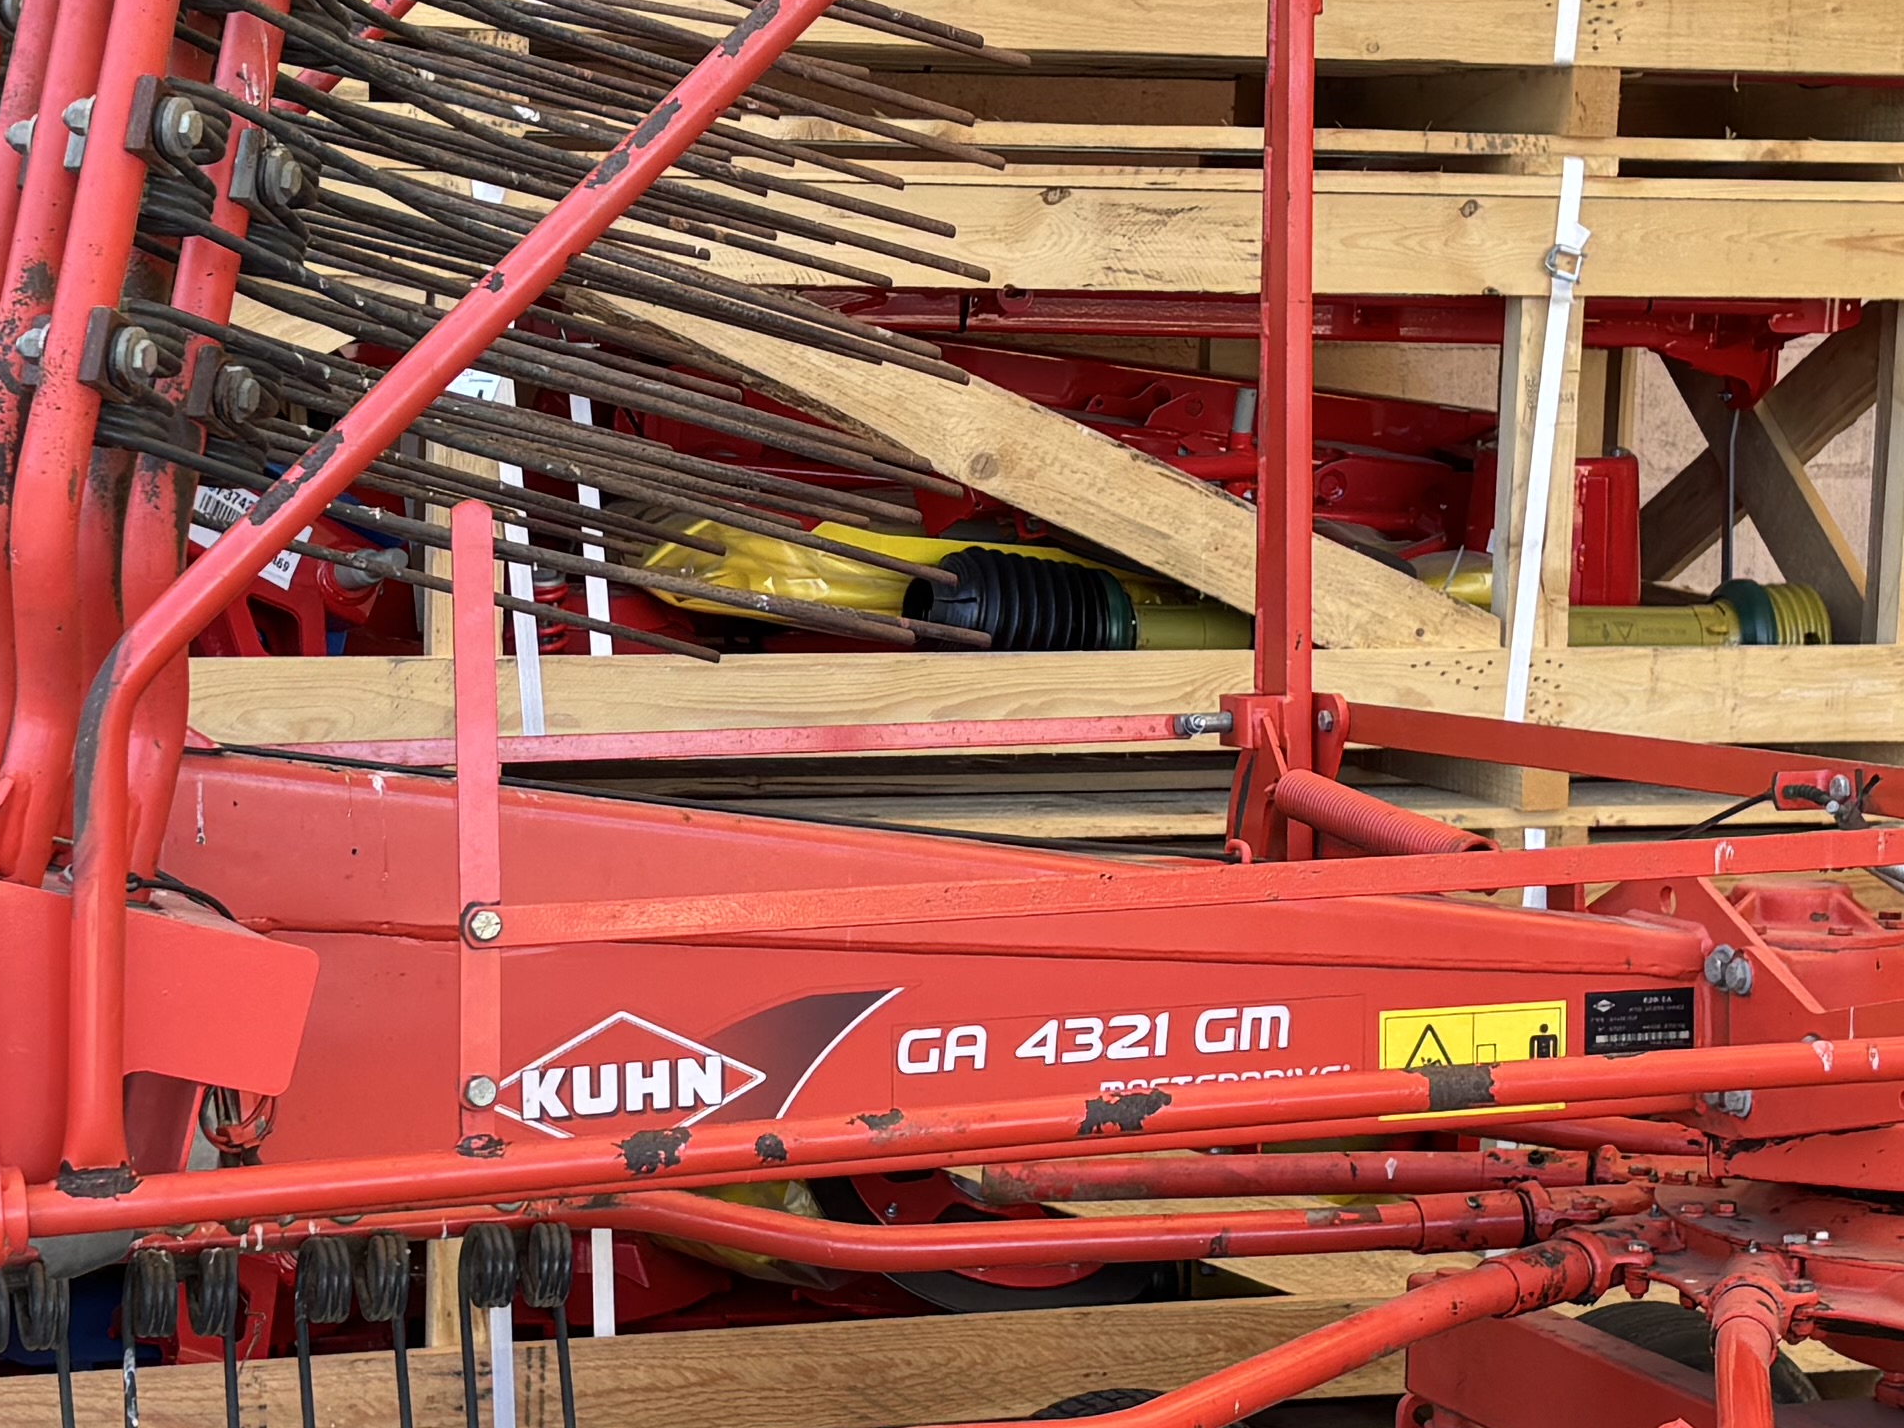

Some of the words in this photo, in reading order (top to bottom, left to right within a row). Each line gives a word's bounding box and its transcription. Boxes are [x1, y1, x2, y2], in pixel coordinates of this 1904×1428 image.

[896, 1024, 988, 1075] GA
[1014, 1011, 1170, 1066] 4321
[1193, 1004, 1291, 1055] GM
[521, 1055, 724, 1121] KUHN
